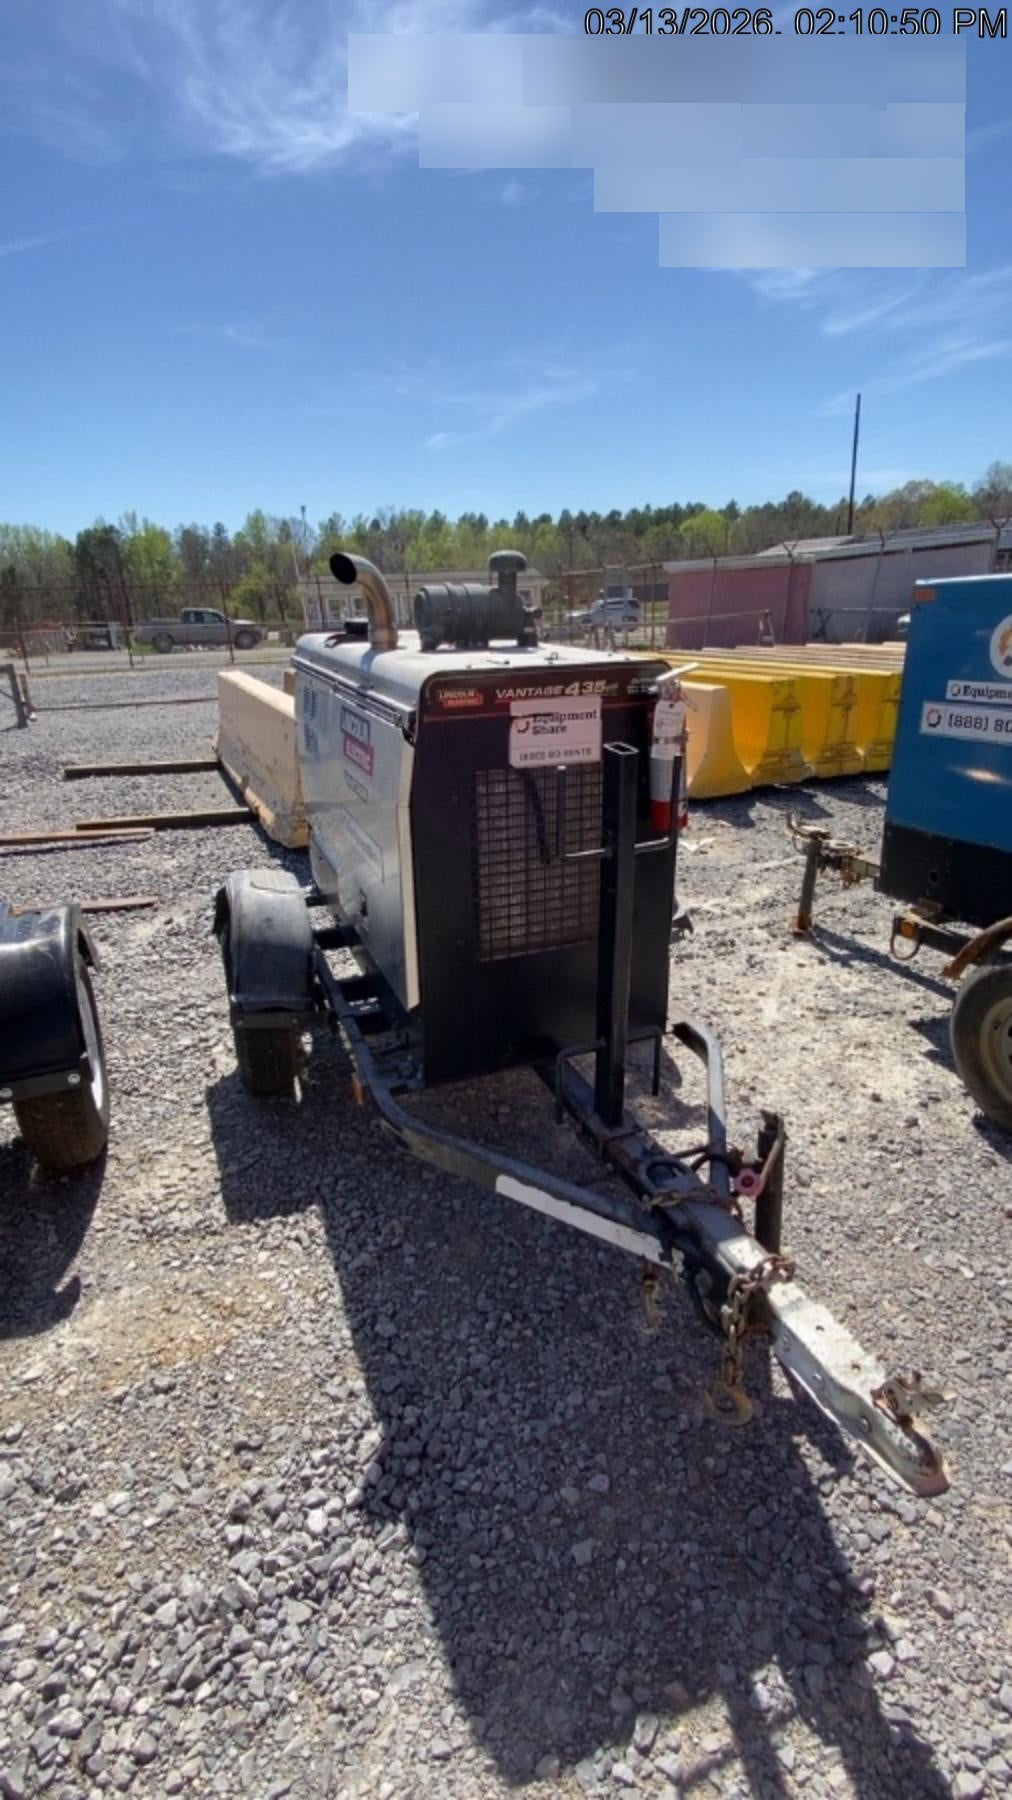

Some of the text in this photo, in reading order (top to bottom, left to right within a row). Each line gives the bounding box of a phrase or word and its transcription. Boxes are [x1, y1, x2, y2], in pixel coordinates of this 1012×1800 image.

[495, 685, 564, 699] VANTAGE
[565, 680, 607, 696] 435
[532, 725, 567, 736] Share
[948, 712, 990, 732] (888)
